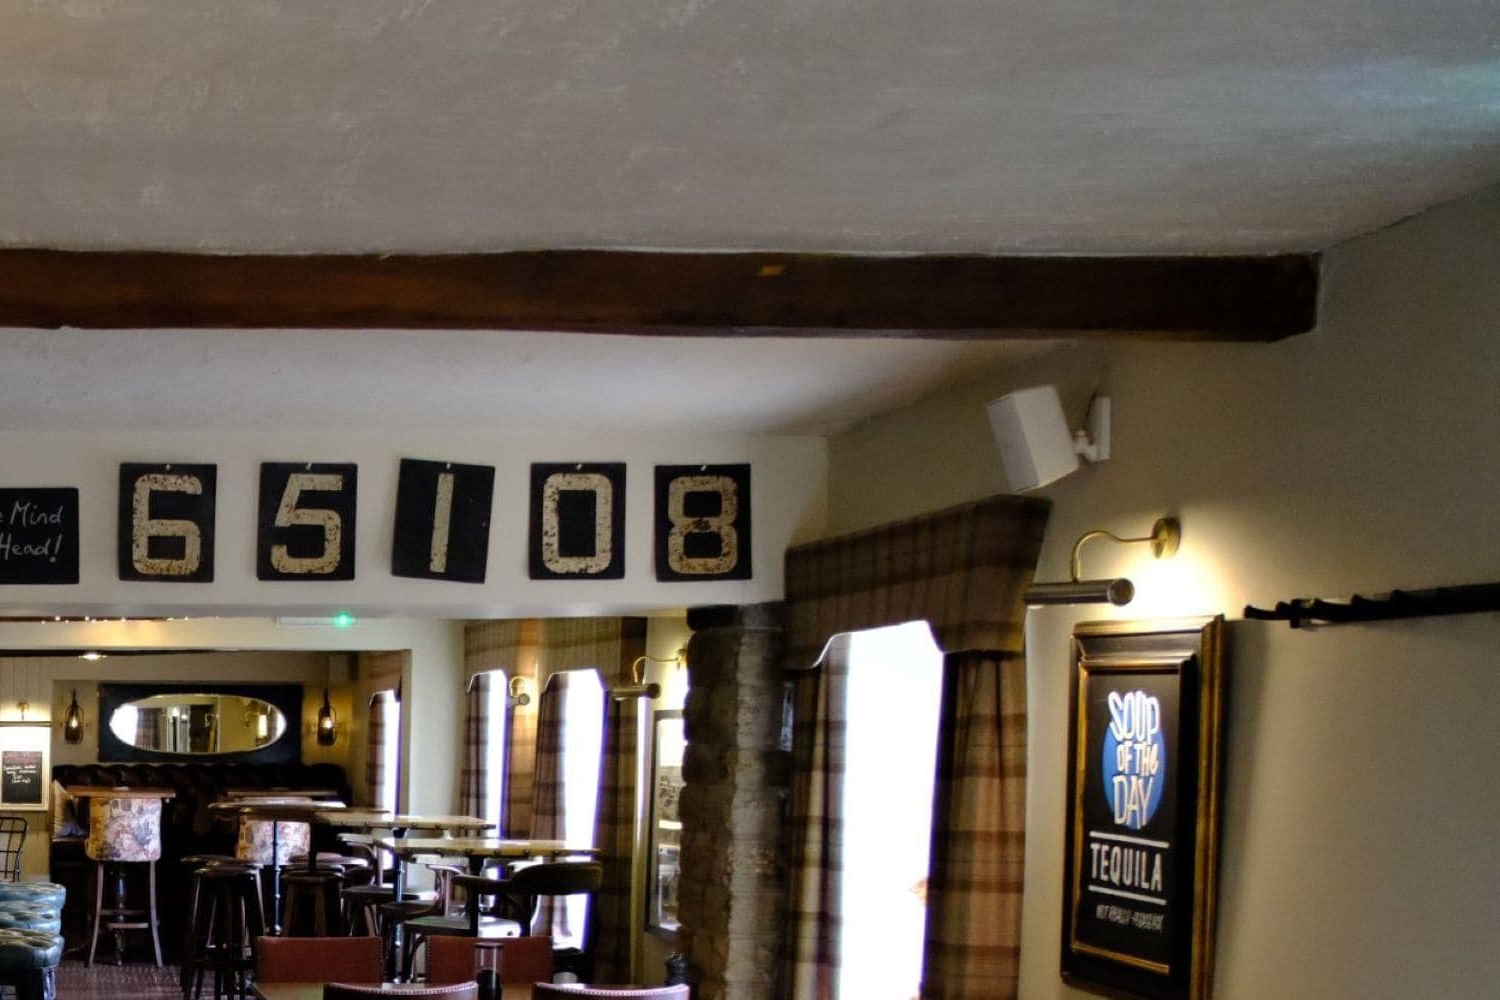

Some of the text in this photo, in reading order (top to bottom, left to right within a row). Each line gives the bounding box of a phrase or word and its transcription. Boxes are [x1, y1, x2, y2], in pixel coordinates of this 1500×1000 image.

[10, 500, 64, 527] Mind
[132, 474, 203, 575] 6
[271, 473, 343, 574] 5
[430, 472, 454, 574] 1
[542, 473, 613, 574] 0
[667, 475, 738, 574] 8
[1108, 690, 1161, 745] SOUP
[1116, 740, 1132, 774] OF
[1112, 774, 1155, 829] DAY
[1090, 842, 1163, 891] TEQUILA
